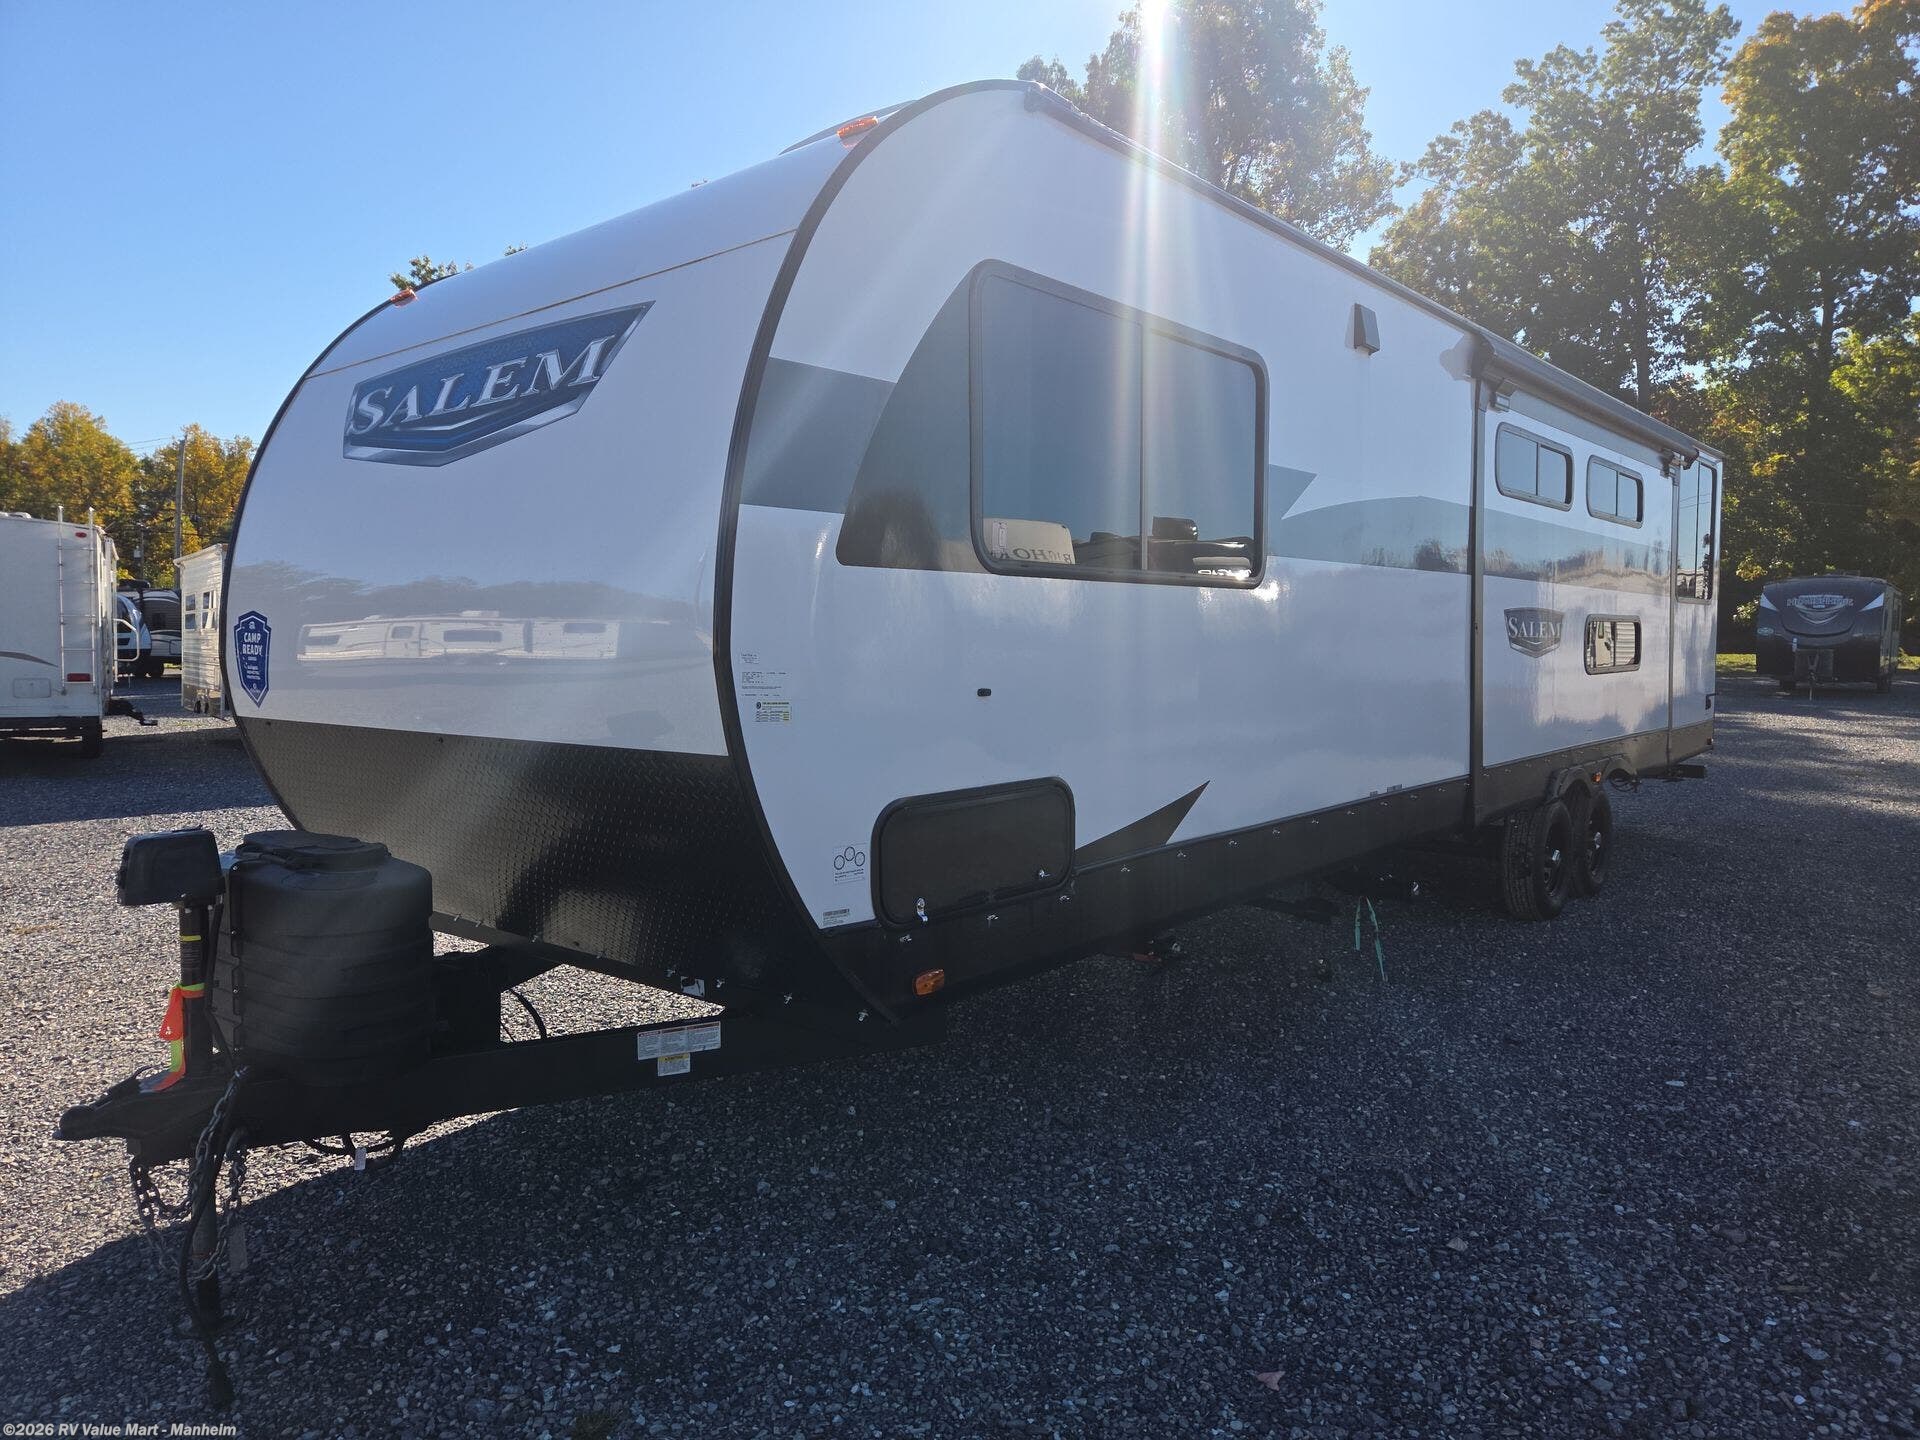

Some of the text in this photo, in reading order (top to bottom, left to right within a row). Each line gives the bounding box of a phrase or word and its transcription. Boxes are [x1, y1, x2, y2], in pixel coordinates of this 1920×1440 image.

[346, 334, 615, 435] SALEM
[1508, 616, 1561, 639] SALEM
[243, 632, 262, 643] CAMP
[242, 644, 263, 656] READY
